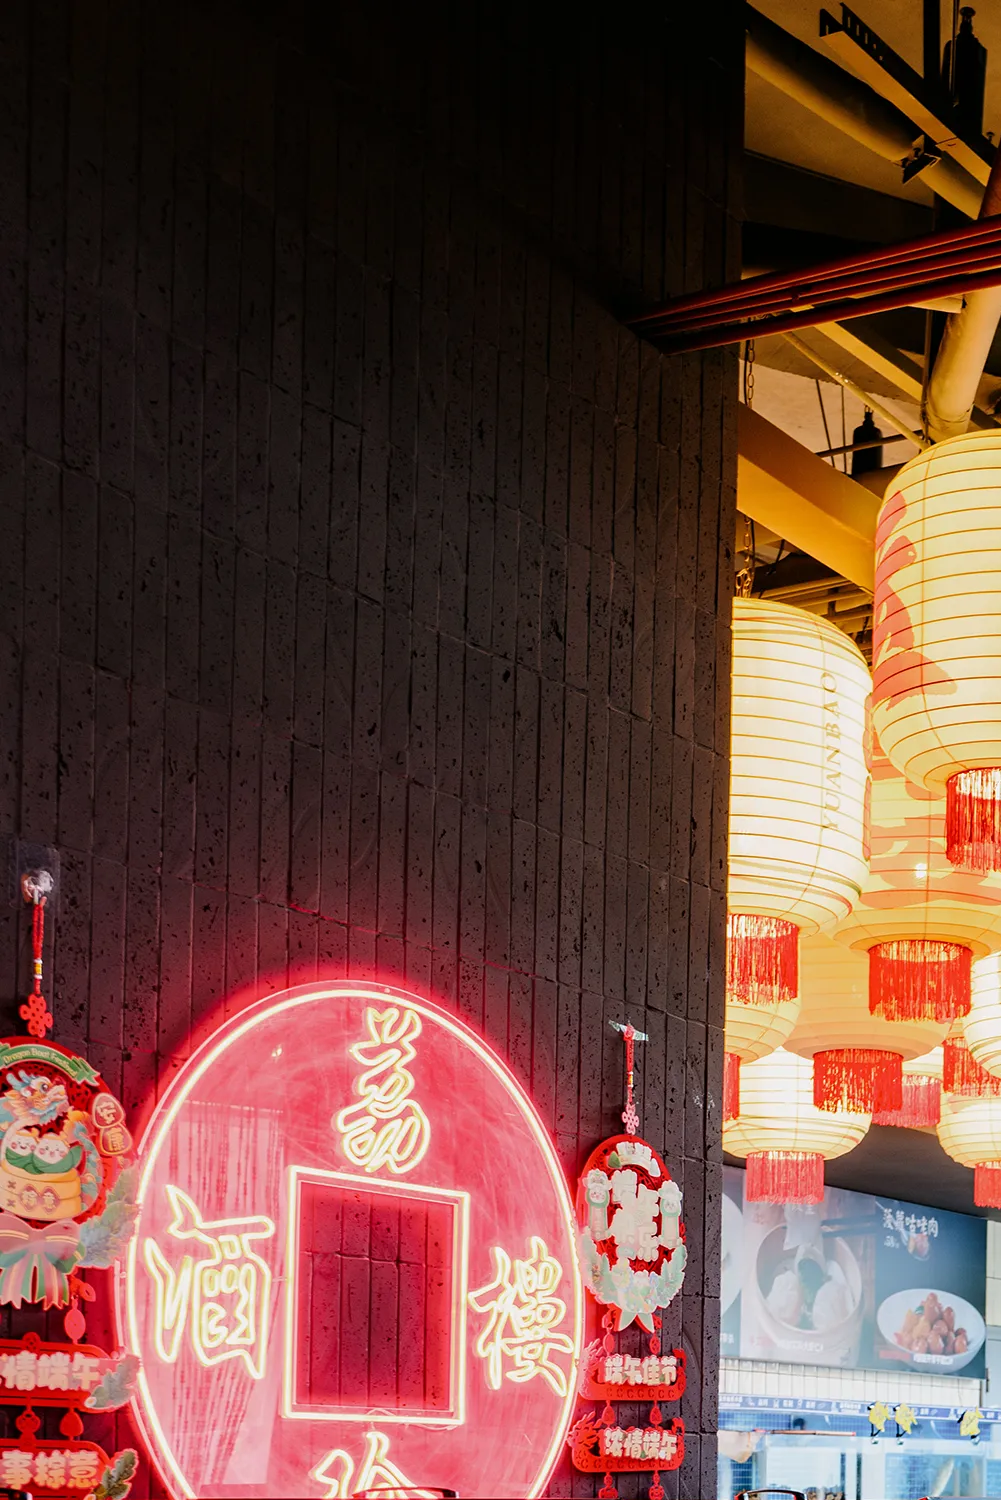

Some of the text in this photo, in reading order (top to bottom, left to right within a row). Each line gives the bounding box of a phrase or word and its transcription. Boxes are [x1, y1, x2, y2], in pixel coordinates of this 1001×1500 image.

[820, 671, 841, 829] YUANBAO
[144, 1184, 276, 1379] 酒
[0, 1350, 100, 1391] 情端午
[604, 1354, 678, 1386] 端午佳节
[604, 1427, 678, 1461] 浓情端午
